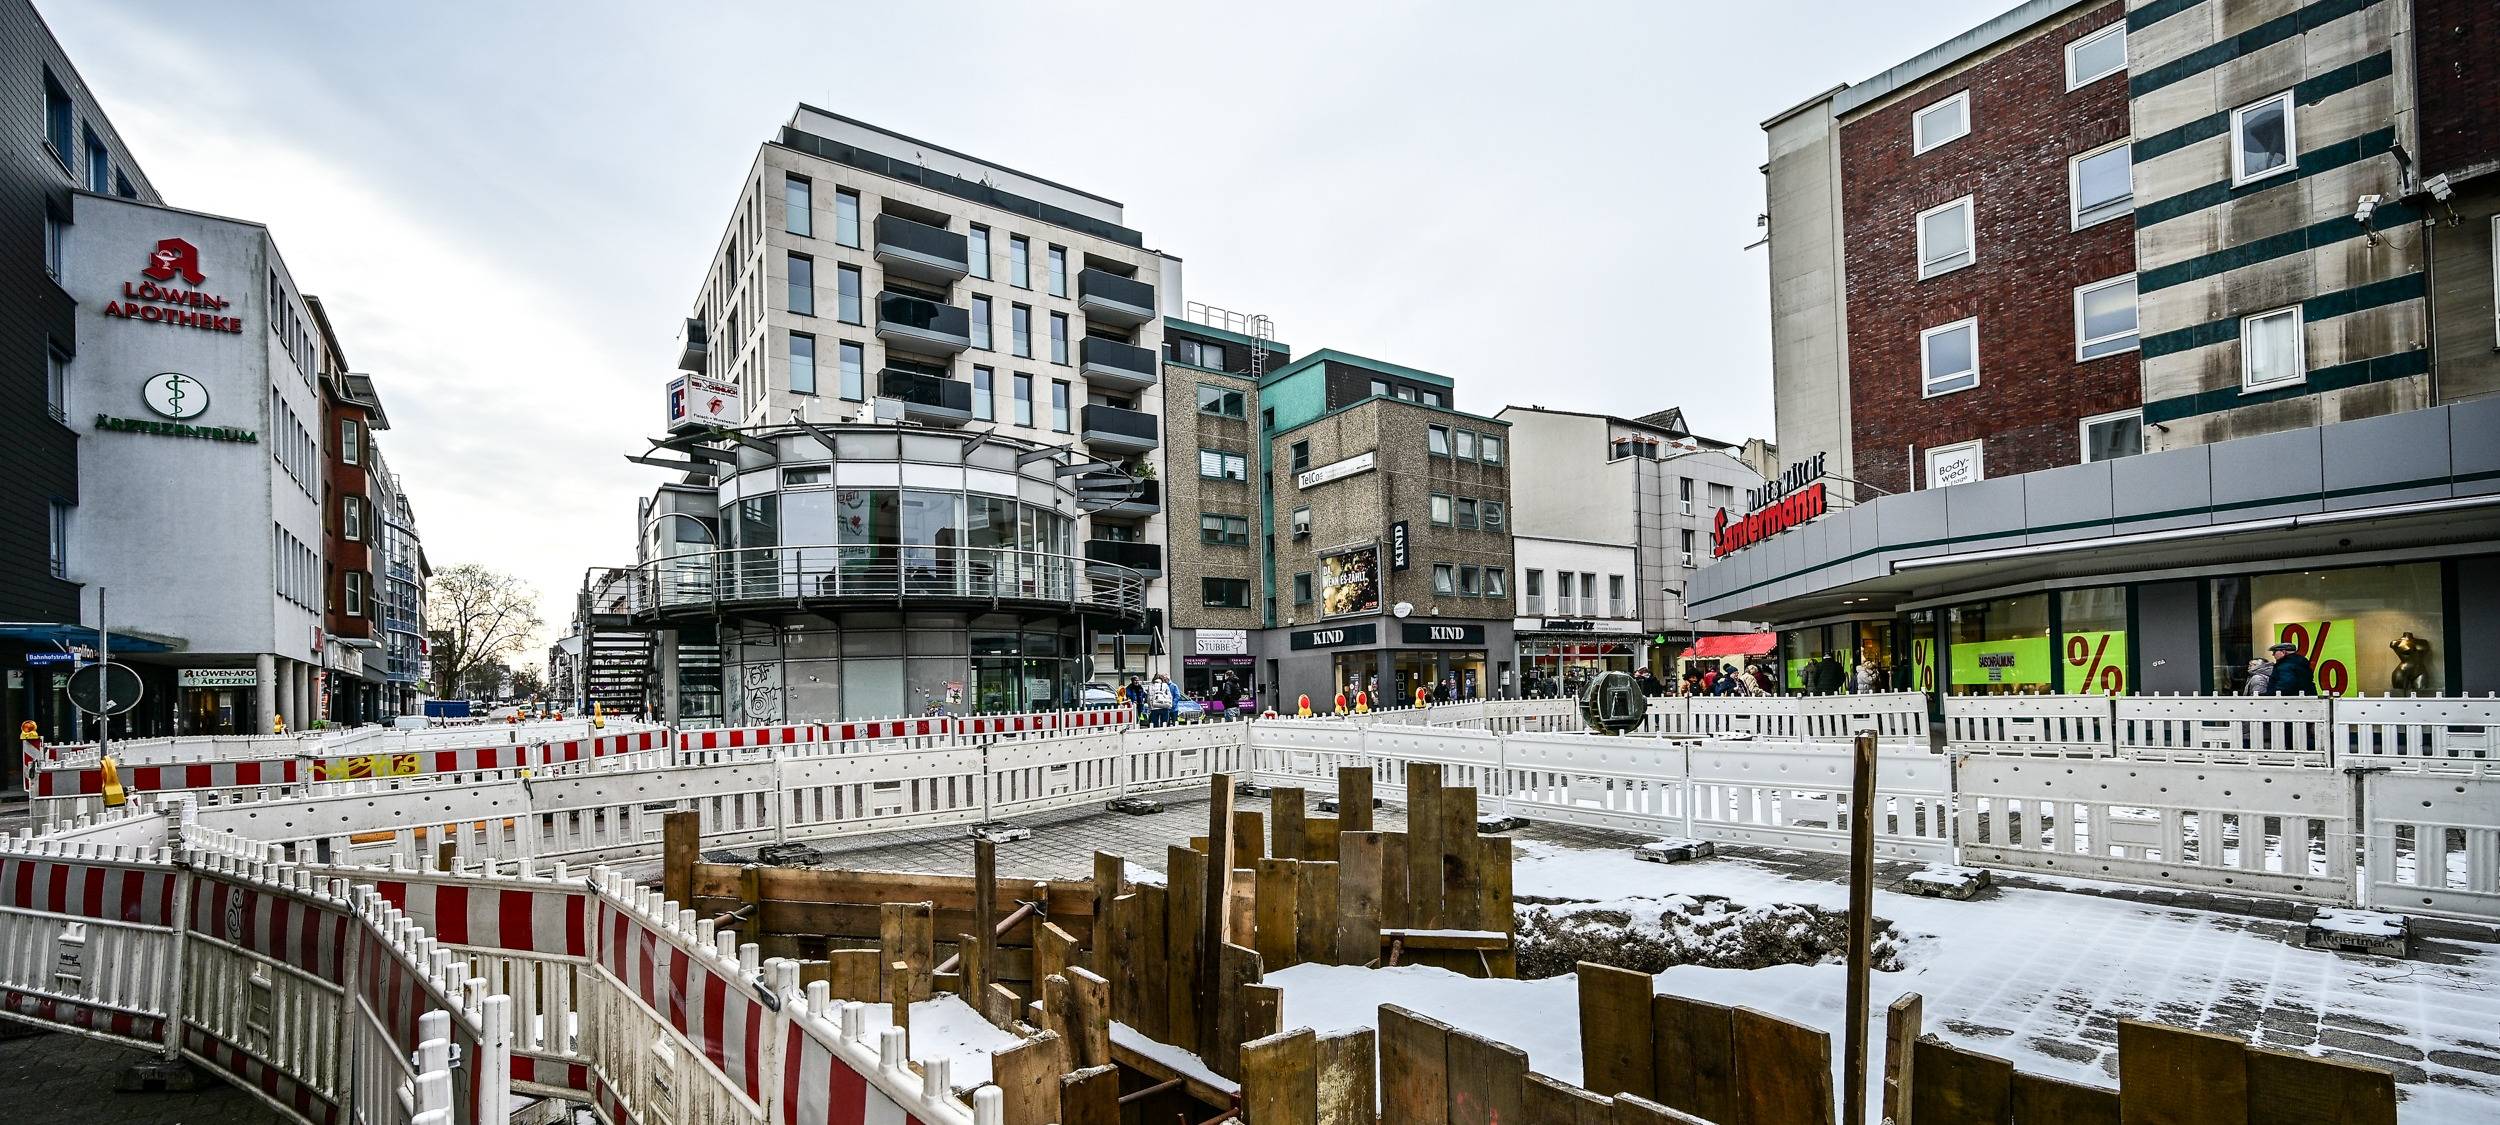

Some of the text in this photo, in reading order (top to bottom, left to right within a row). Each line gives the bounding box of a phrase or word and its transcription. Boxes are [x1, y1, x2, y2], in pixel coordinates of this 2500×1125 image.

[124, 280, 230, 311] LÖWEN-
[104, 300, 242, 333] APOTHEKE
[95, 413, 257, 443] ÄRZTEZENTRUM
[1780, 451, 1827, 495] WÄSCHE
[1939, 458, 1970, 476] Body-
[1941, 466, 1969, 482] wear
[1394, 525, 1404, 567] KIND
[1313, 629, 1344, 645] KIND
[1430, 626, 1464, 640] KIND
[1198, 640, 1231, 651] STUBBE
[196, 669, 256, 677] LÖWEN-APO
